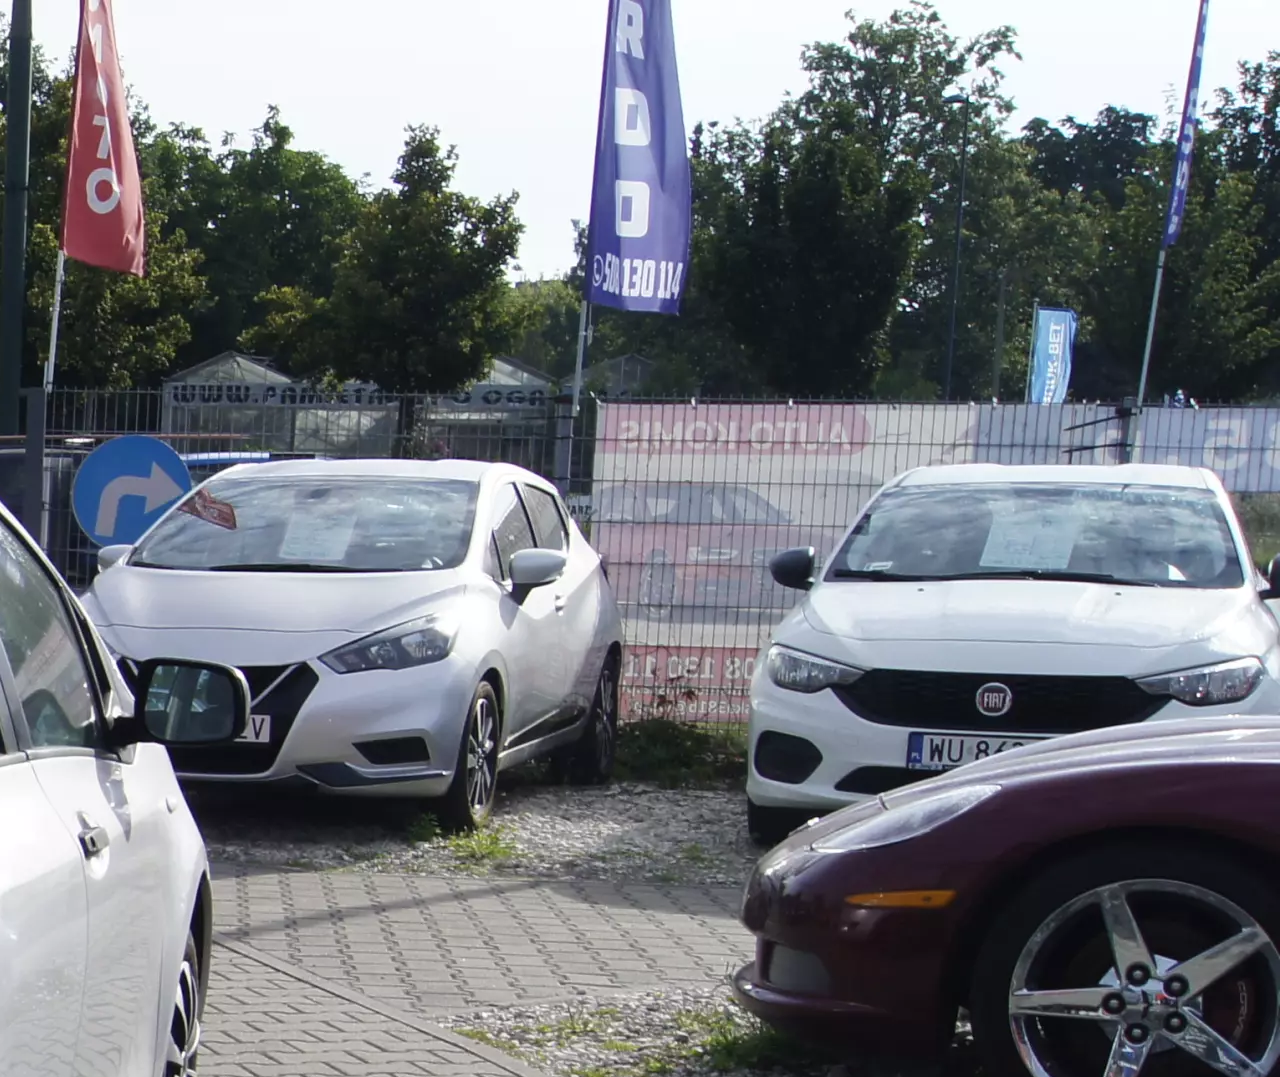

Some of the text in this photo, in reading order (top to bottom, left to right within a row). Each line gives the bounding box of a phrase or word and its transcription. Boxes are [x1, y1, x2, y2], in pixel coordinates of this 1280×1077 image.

[622, 258, 656, 298] 130
[657, 260, 683, 300] 114
[984, 692, 1006, 708] FIAT
[929, 737, 964, 763] WU
